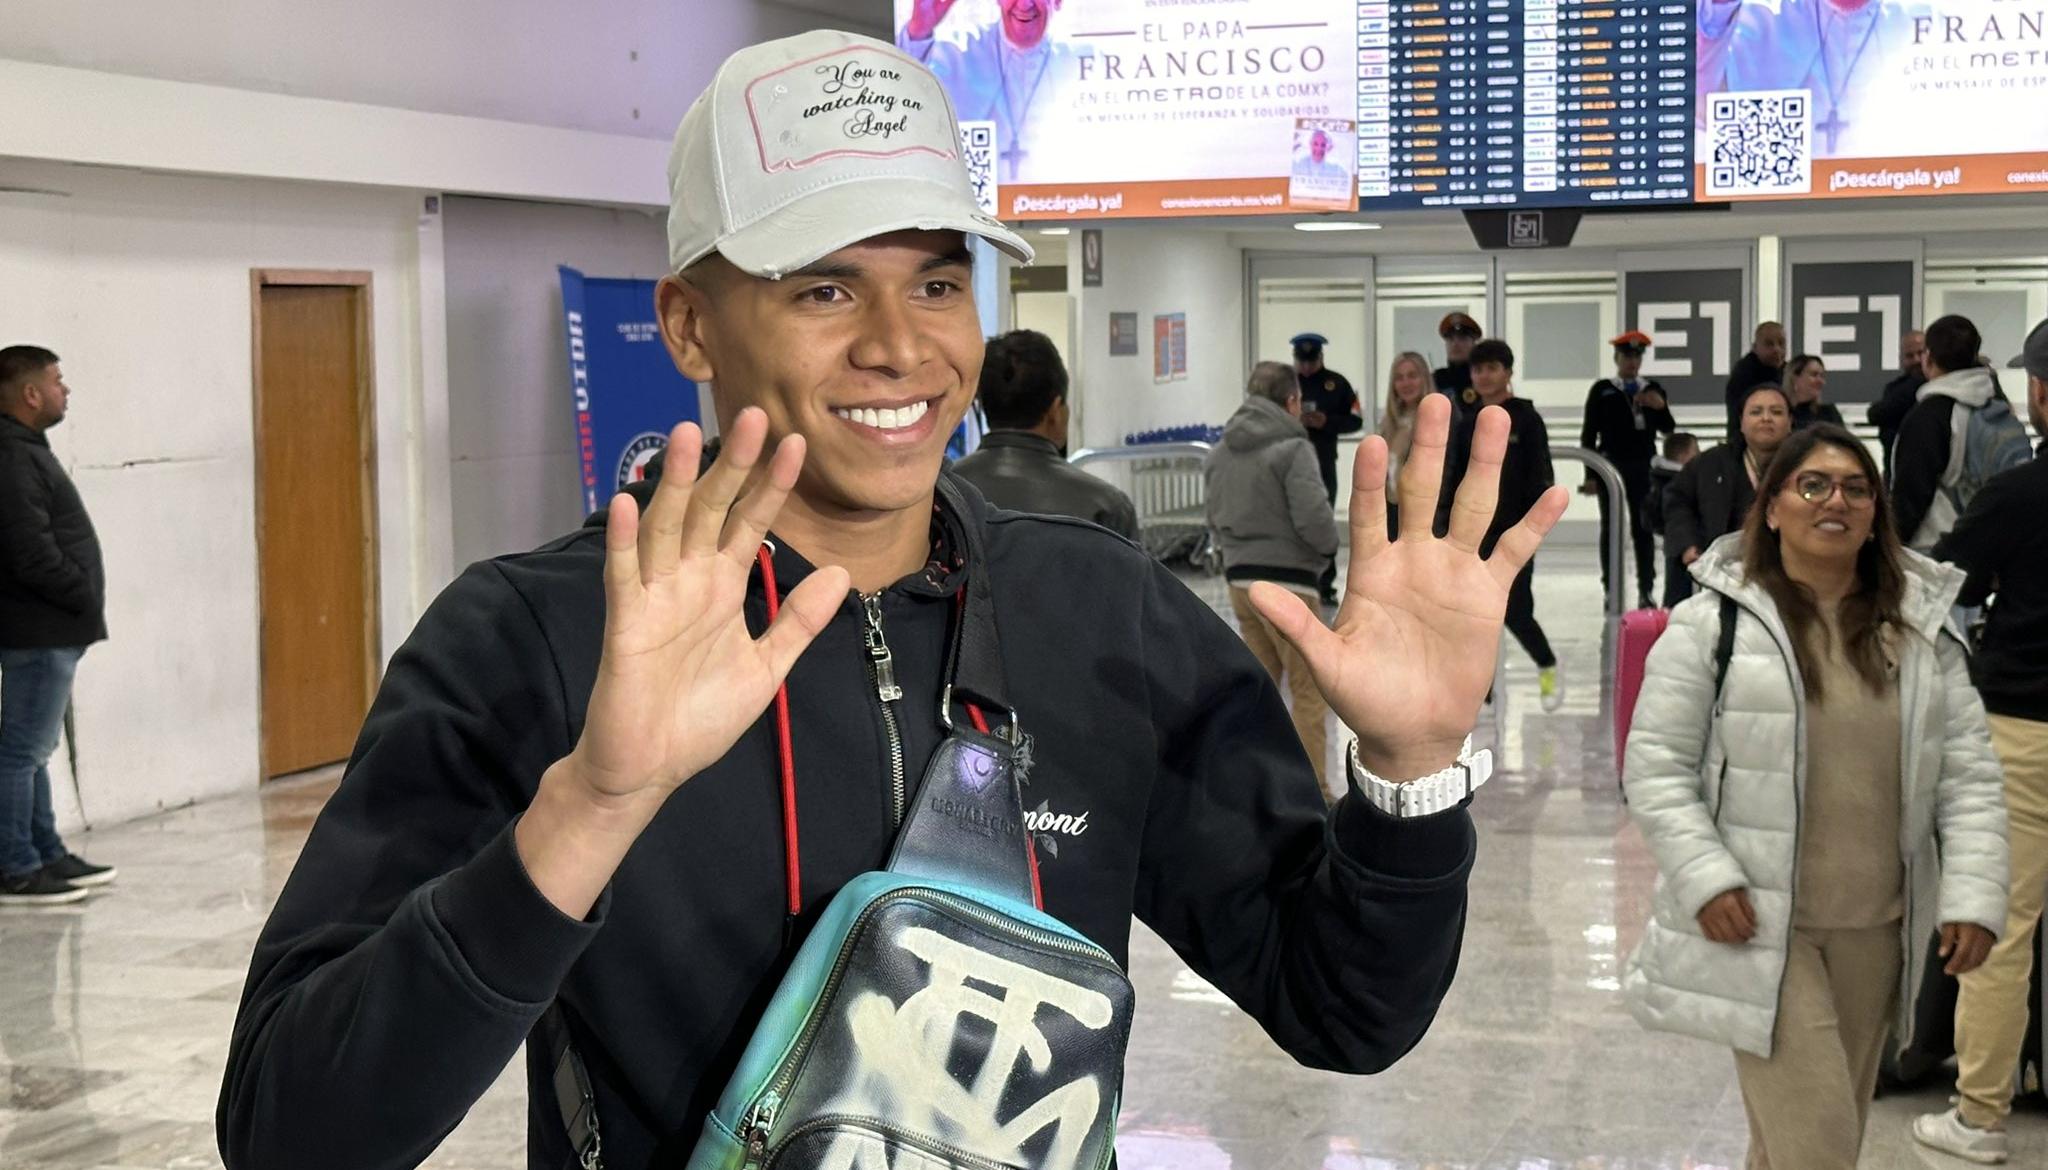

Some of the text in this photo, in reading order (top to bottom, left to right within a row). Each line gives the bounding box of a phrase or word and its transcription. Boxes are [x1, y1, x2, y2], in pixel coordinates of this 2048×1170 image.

[1143, 20, 1244, 43] EL PAPA
[1912, 10, 2044, 45] FRAN
[815, 60, 901, 94] You are
[1078, 45, 1325, 81] FRANCISCO
[1943, 55, 1960, 70] EL
[803, 86, 924, 119] watching an
[1127, 86, 1223, 102] METRO
[1226, 86, 1245, 100] DE
[1251, 85, 1270, 99] LA
[842, 108, 908, 139] Angel
[1253, 105, 1330, 119] SOLIDARIDAD
[1830, 167, 1961, 192] ¡Descárgala ya!
[1013, 191, 1123, 215] ¡Descárgala ya!
[1637, 301, 1731, 376] E1
[1804, 295, 1901, 372] E1
